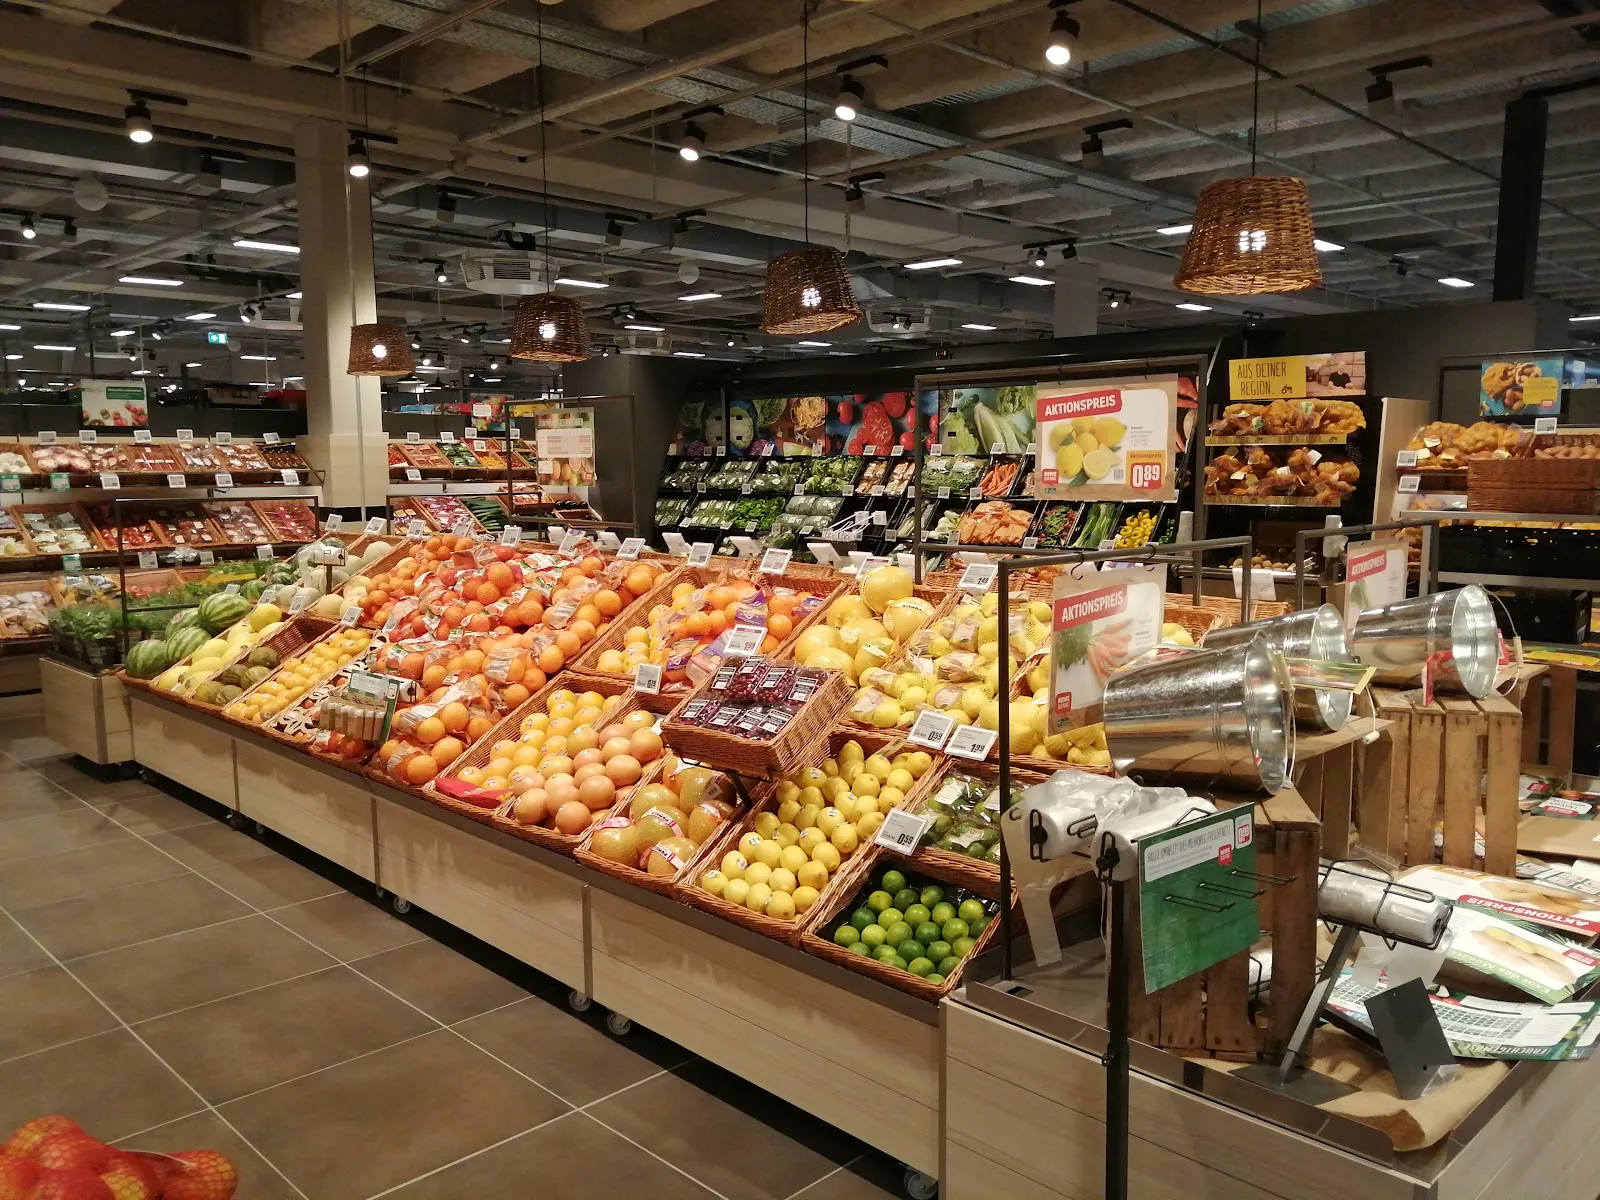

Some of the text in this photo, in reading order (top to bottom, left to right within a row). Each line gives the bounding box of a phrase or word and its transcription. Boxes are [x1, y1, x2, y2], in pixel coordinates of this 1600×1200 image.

[1237, 361, 1287, 379] AUS DEINER
[1044, 394, 1116, 417] AKTIONSPREIS
[1132, 464, 1160, 488] 0.89
[1061, 590, 1123, 622] AKTIONSPREIS
[1467, 896, 1590, 927] AKTIONSPREIS
[1496, 966, 1521, 981] des
